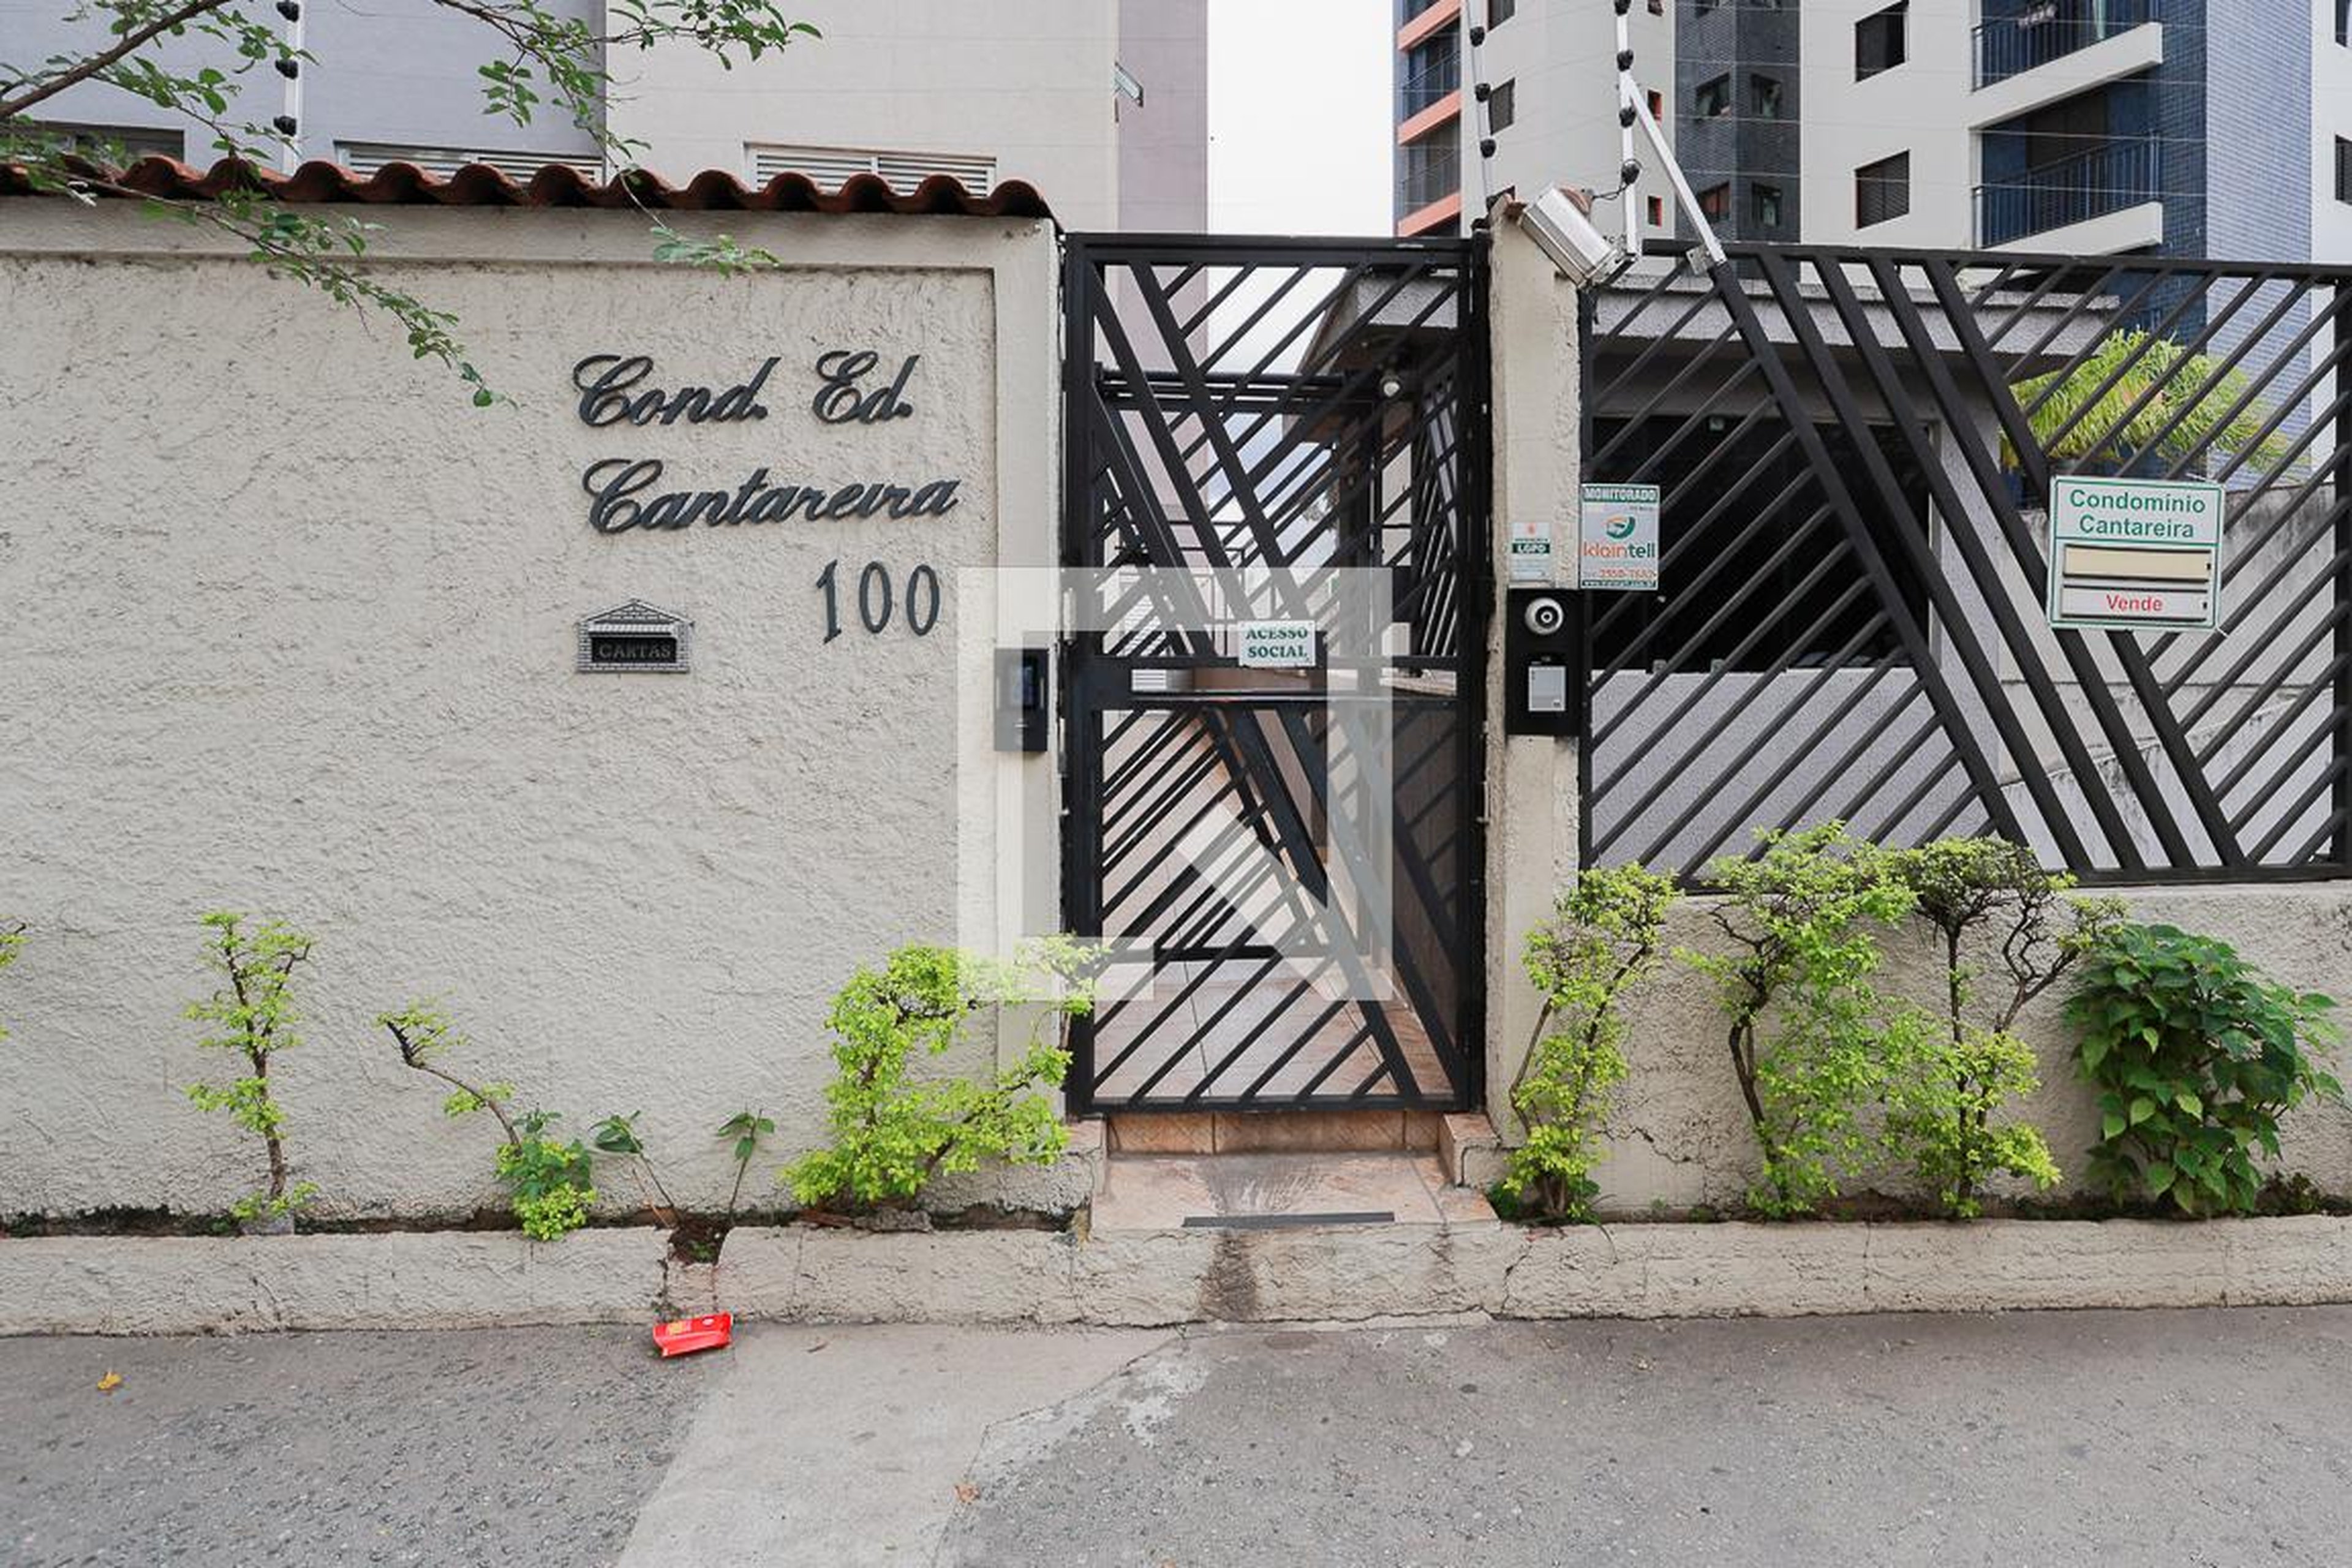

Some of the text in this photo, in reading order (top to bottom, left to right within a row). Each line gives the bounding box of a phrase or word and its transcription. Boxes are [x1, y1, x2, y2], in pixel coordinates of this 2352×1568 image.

[573, 350, 920, 428] Cond. Ed.
[582, 458, 961, 534] Cantareira
[1582, 488, 1657, 502] MONITORADO
[2079, 514, 2194, 538] Cantareira
[816, 559, 940, 644] 100
[2106, 594, 2163, 611] Vende
[1246, 628, 1308, 639] ACESSO
[599, 643, 671, 659] CARTAS
[1248, 645, 1307, 658] SOCIAL
